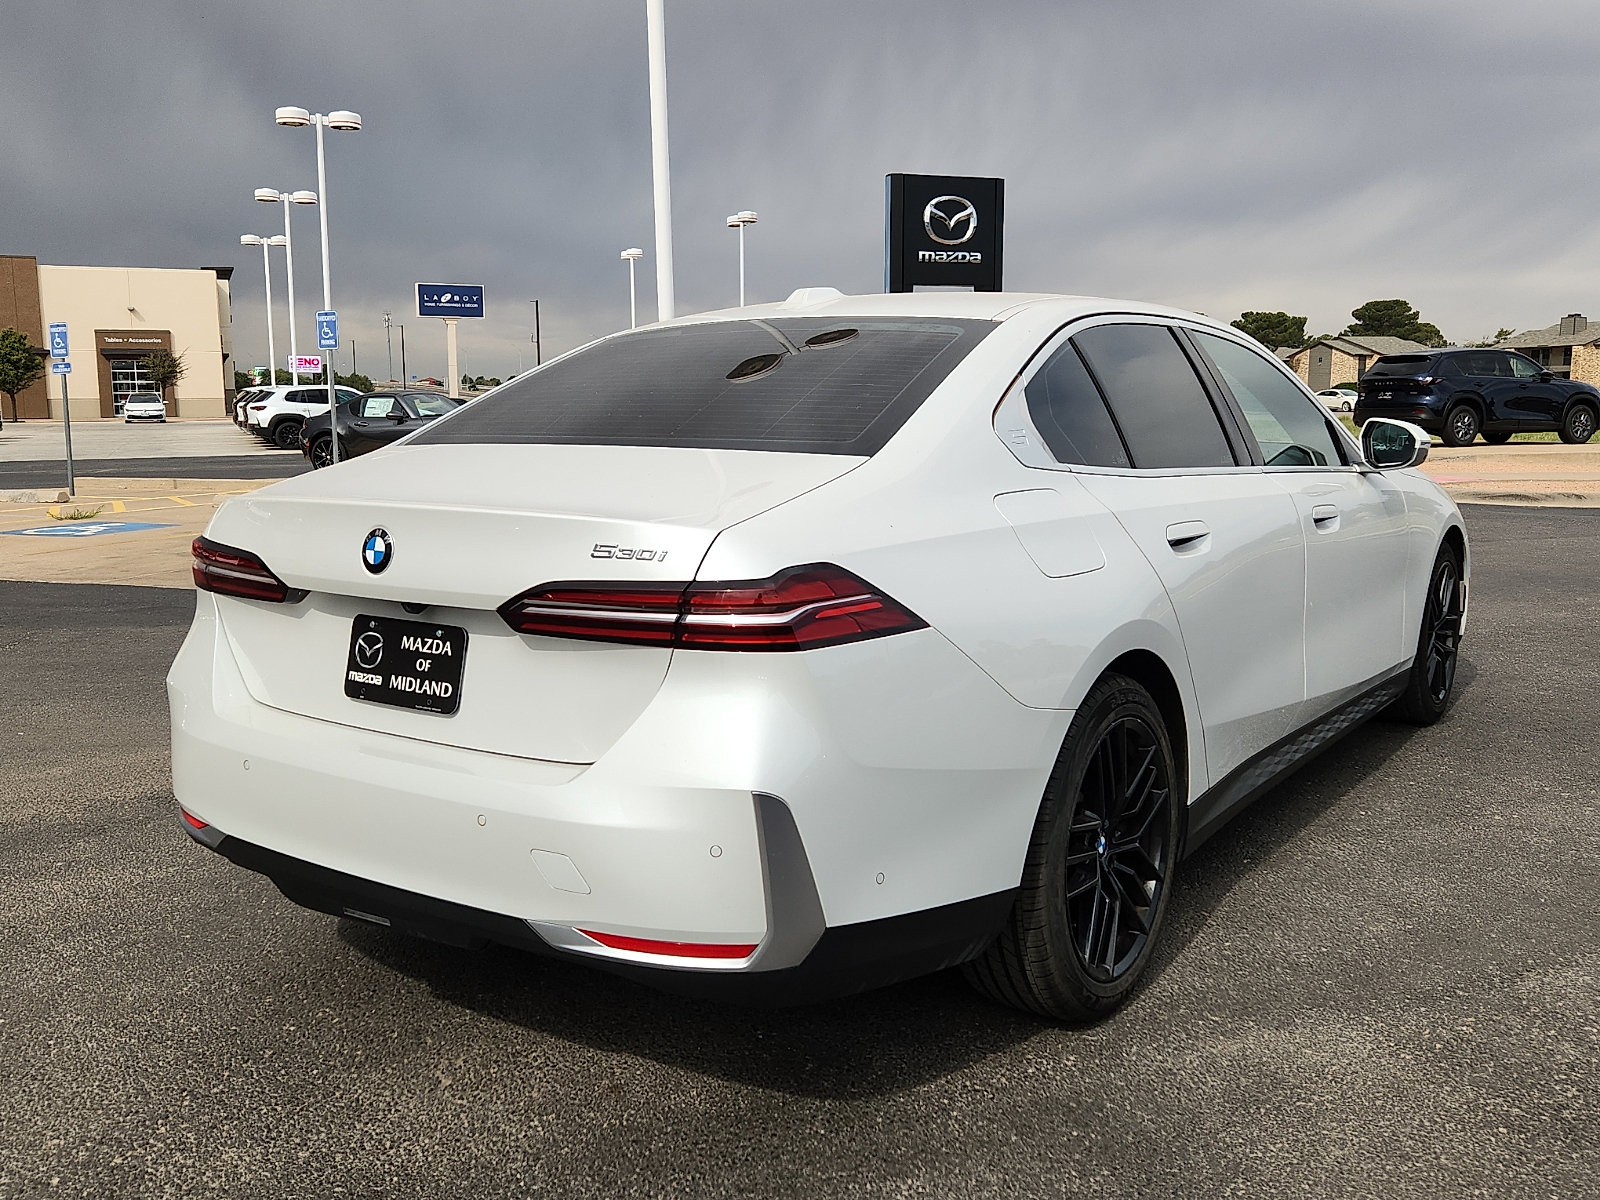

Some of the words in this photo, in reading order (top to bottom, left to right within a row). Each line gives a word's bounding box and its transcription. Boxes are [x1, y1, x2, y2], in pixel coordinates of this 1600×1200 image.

[590, 543, 668, 562] 530i
[401, 635, 452, 656] MAZDA
[415, 658, 432, 672] OF
[389, 674, 453, 698] MIDLAND
